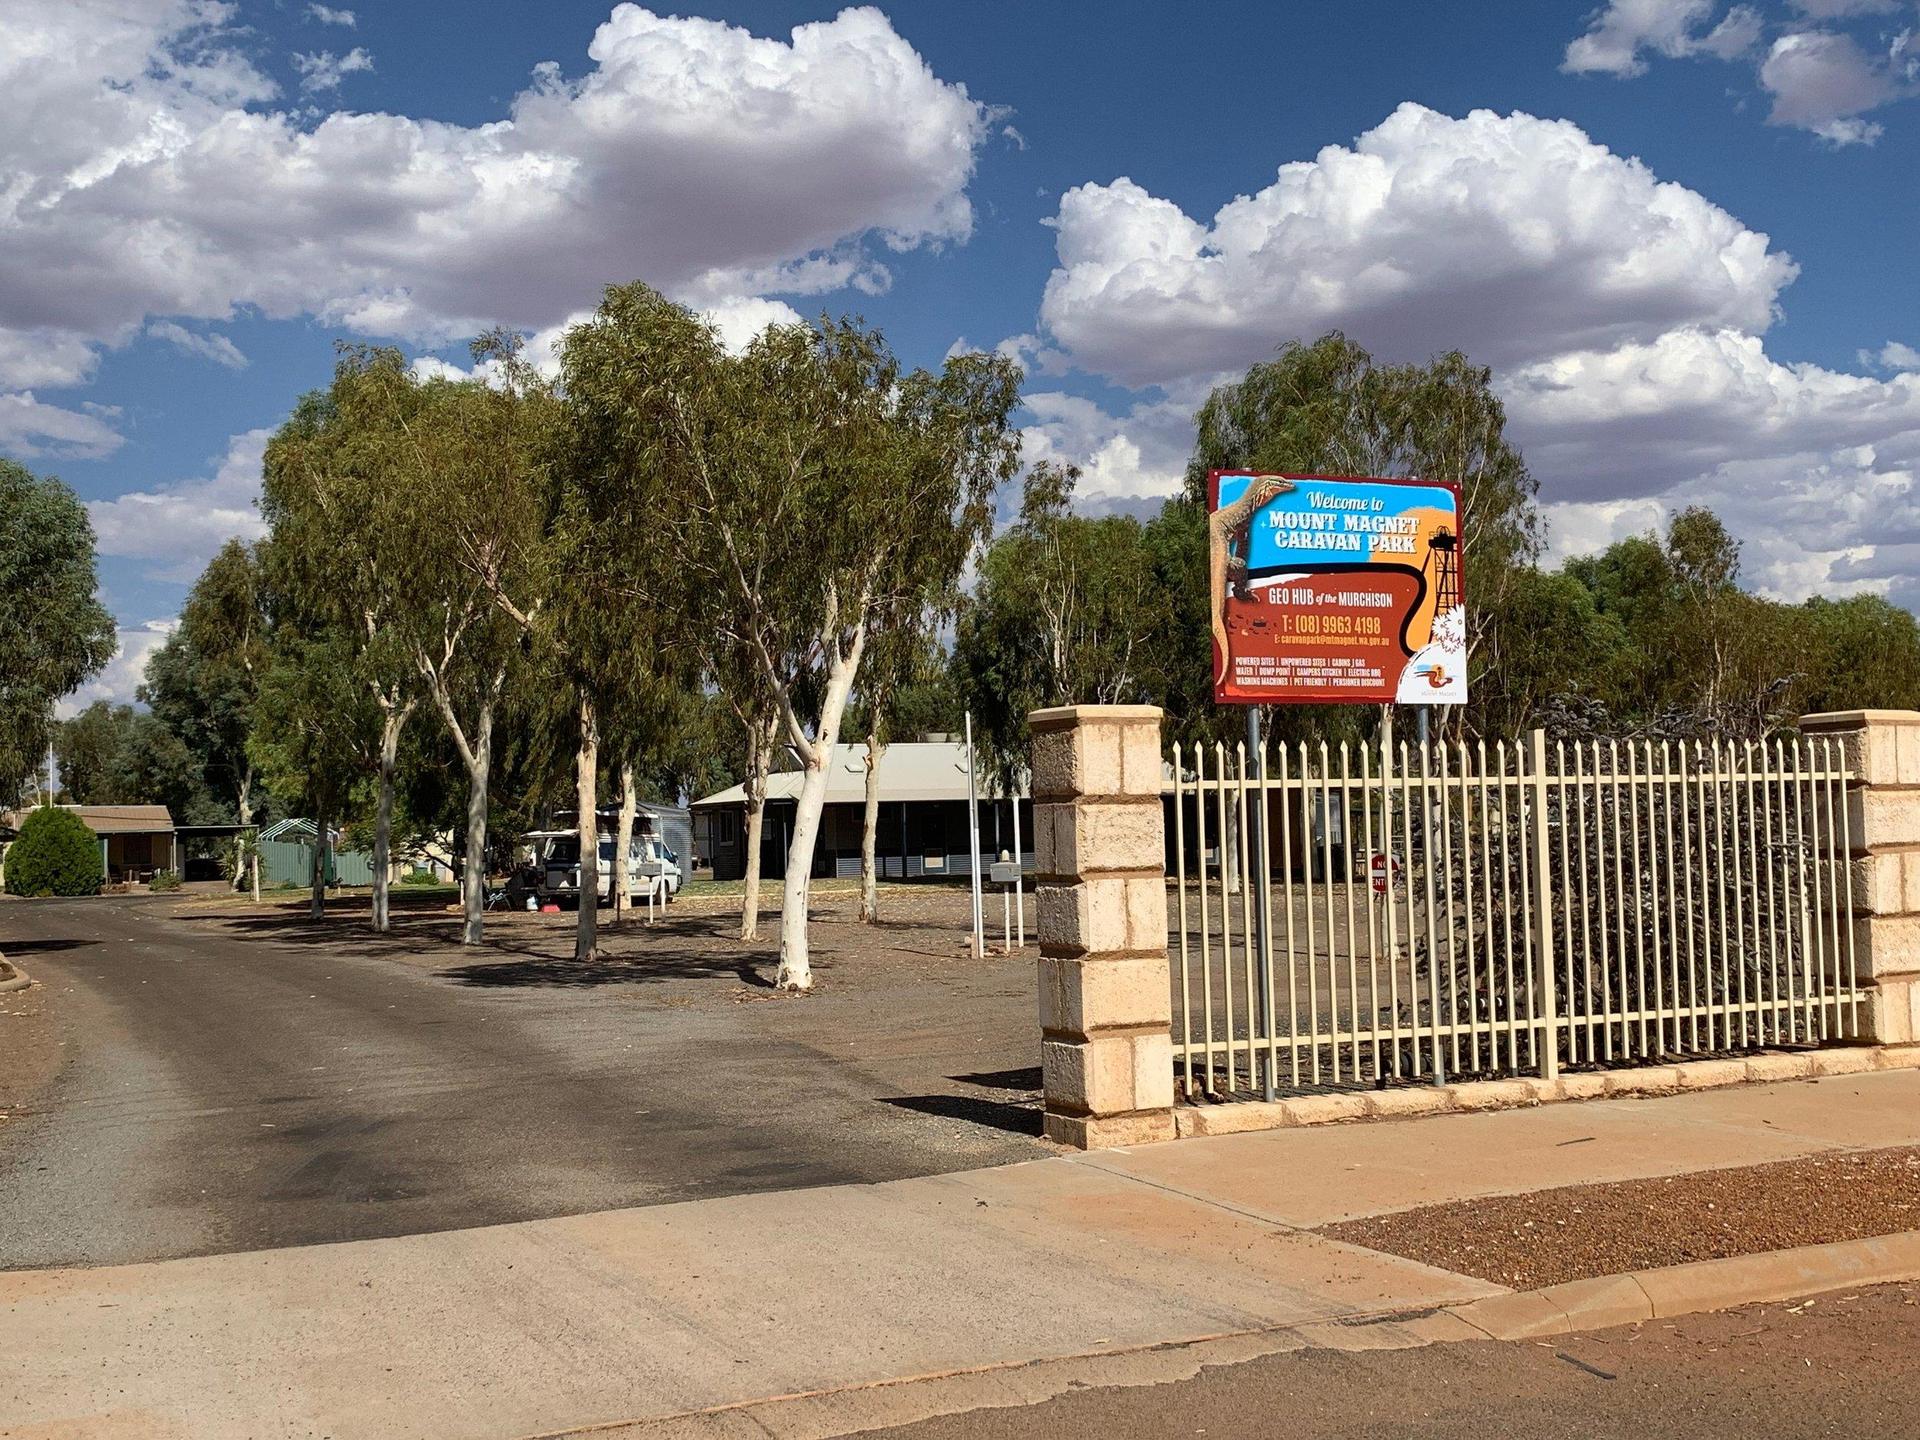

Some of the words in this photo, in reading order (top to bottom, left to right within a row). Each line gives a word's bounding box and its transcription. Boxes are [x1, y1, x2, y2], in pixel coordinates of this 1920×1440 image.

[1306, 491, 1368, 511] Welcome
[1371, 496, 1384, 511] to
[1269, 510, 1338, 531] MOUNT
[1343, 514, 1420, 534] MAGNET
[1274, 530, 1362, 551] CARAVAN
[1367, 534, 1417, 554] PARK
[1269, 588, 1289, 605] GEO
[1292, 588, 1314, 605] HUB
[1315, 593, 1324, 606] of
[1324, 594, 1337, 604] the
[1338, 591, 1393, 608] MURCHISON
[1282, 614, 1292, 632] T:
[1295, 614, 1320, 634] (08)
[1322, 615, 1351, 634] 9963
[1354, 616, 1381, 635] 4198
